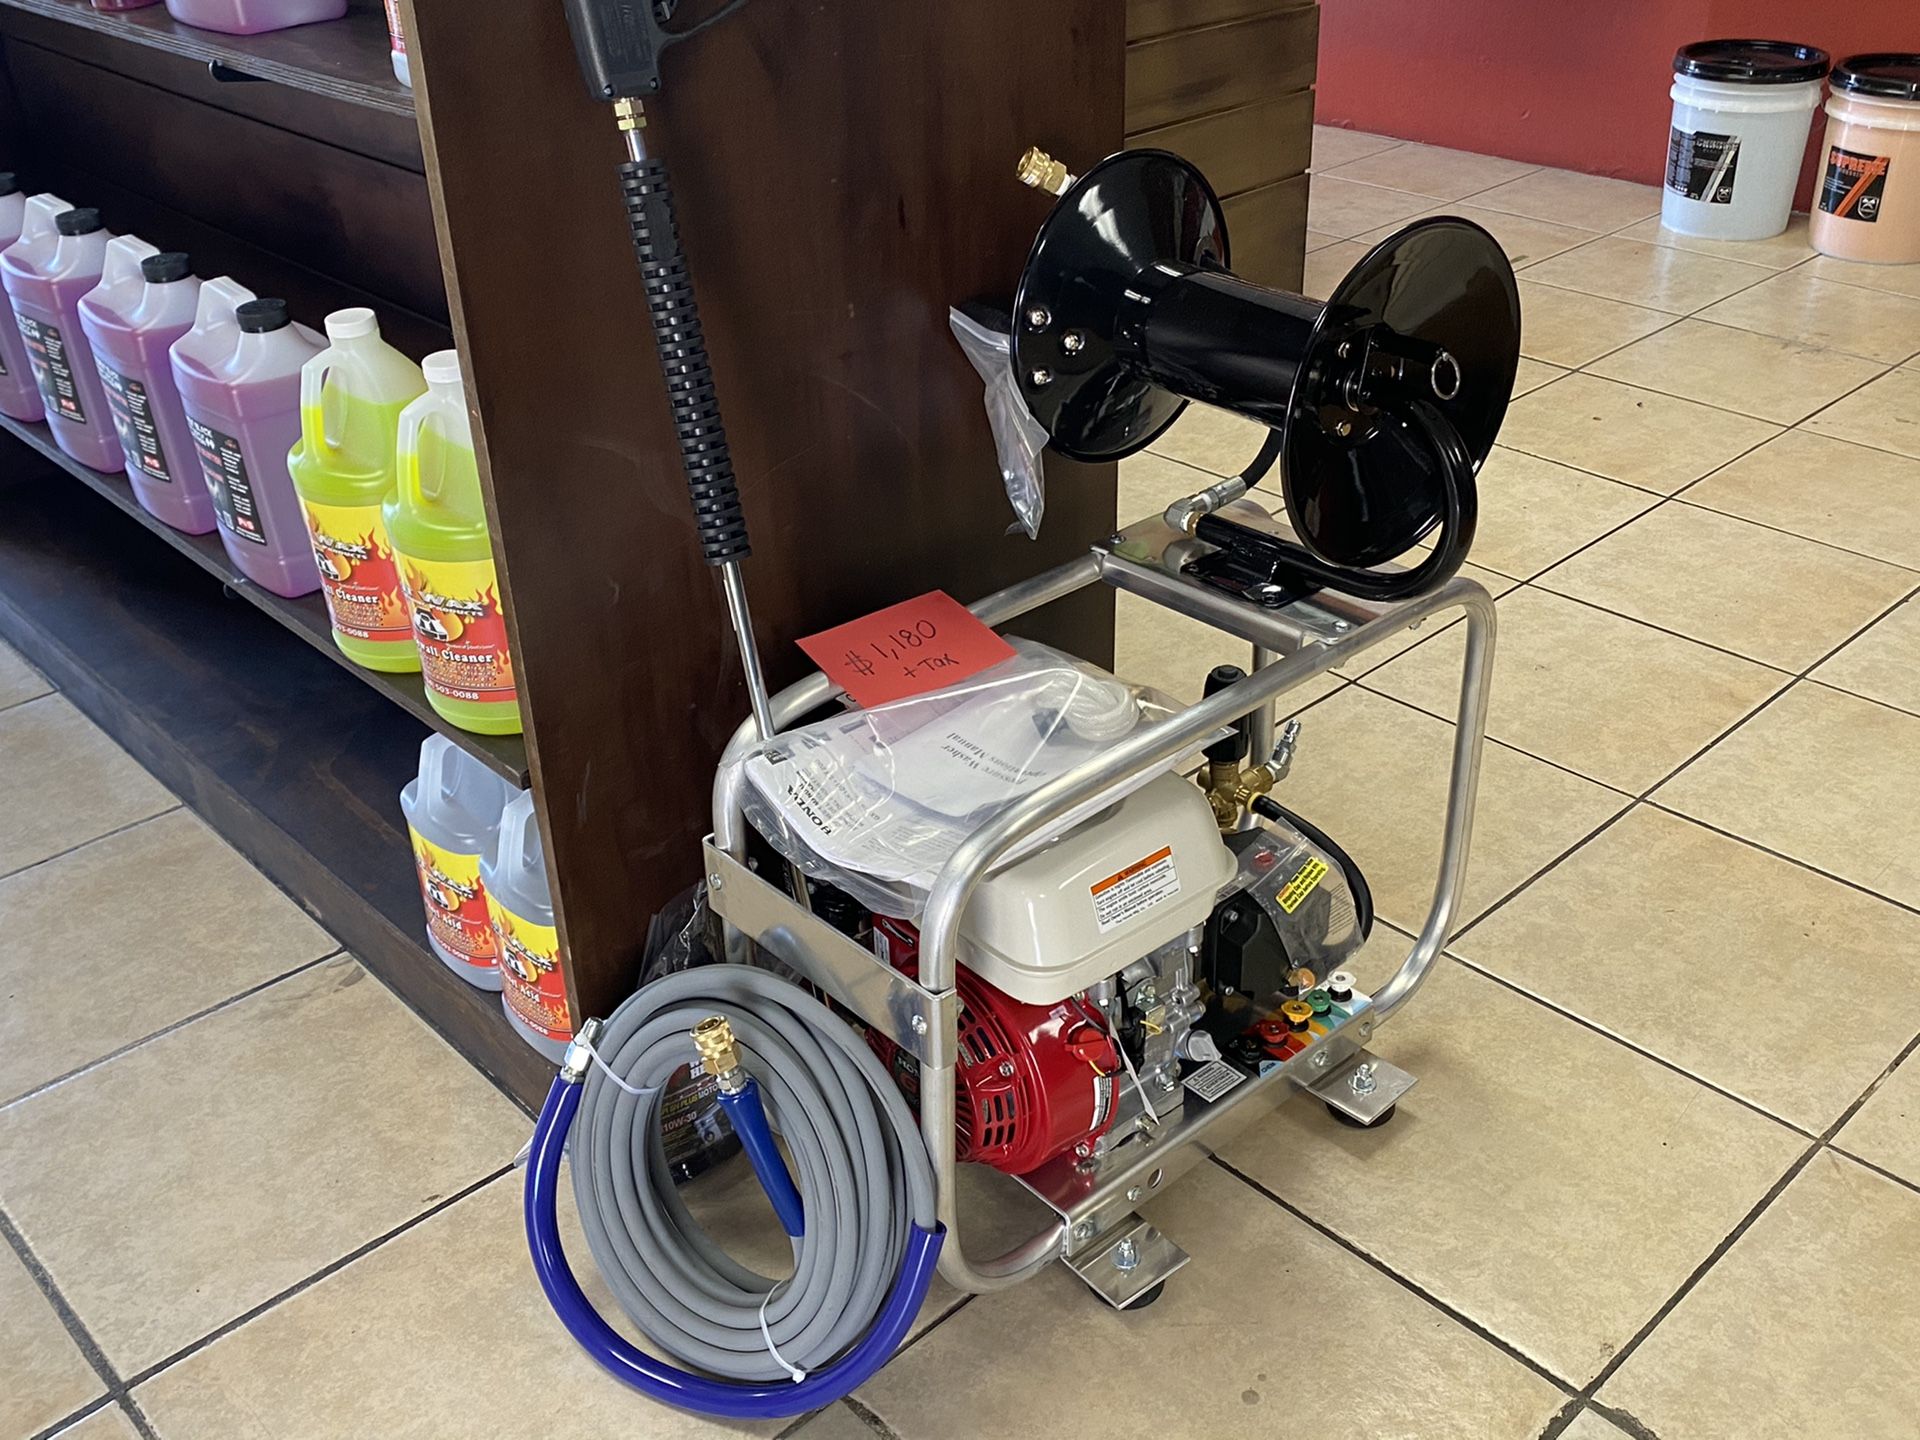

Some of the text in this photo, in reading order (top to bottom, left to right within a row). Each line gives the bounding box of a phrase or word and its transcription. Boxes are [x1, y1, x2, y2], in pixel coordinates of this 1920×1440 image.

[335, 587, 380, 604] Cleaner
[418, 590, 484, 612] WAX
[441, 648, 494, 664] Cleaner
[435, 683, 480, 700] 503-0088
[698, 1083, 719, 1099] MOTO
[663, 1111, 698, 1132] 10W-30
